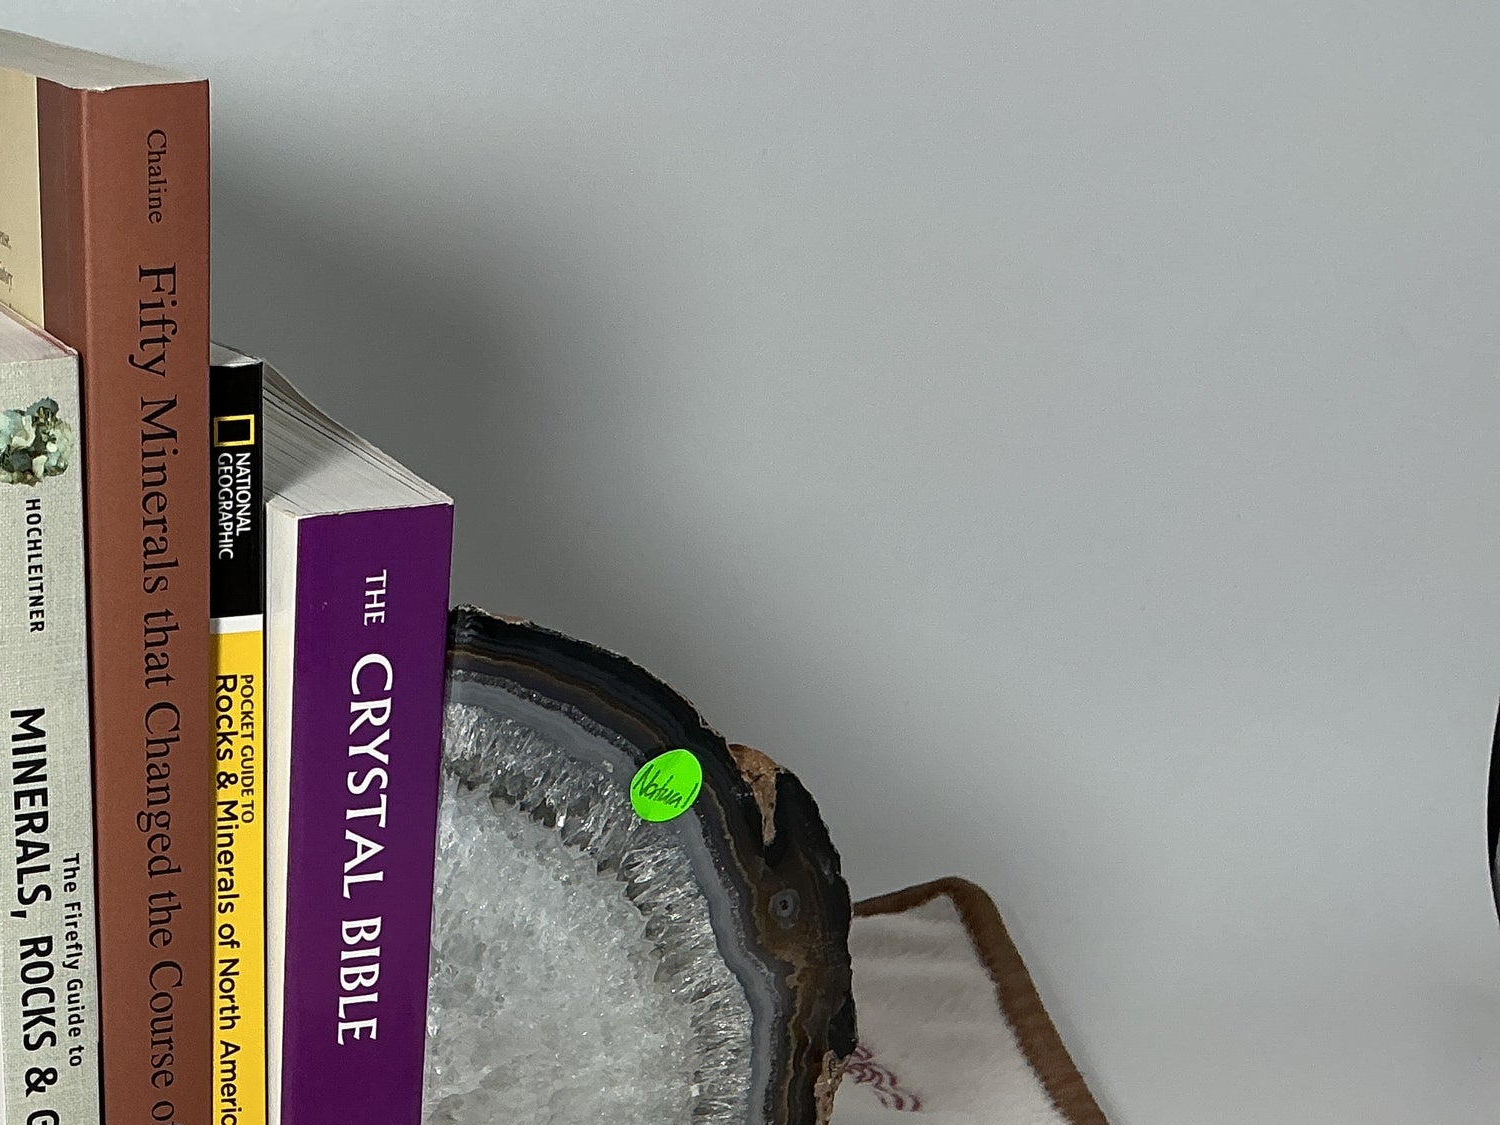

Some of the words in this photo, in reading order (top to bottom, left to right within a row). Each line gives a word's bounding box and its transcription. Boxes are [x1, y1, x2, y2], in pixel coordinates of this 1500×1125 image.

[147, 128, 167, 224] Chaline
[128, 262, 179, 378] Fifty
[140, 394, 180, 595] Minerals
[217, 452, 234, 560] GEOGRAPHIC
[235, 452, 252, 537] NATIONAL
[25, 497, 45, 633] HOCHLEITNER
[363, 568, 387, 627] THE
[143, 608, 180, 690] that
[215, 673, 238, 762] Rocks
[240, 674, 254, 741] POCKET
[137, 701, 181, 880] Changed
[216, 770, 239, 790] &
[240, 745, 255, 797] GUIDE
[240, 799, 255, 823] TO
[342, 653, 393, 900] CRYSTAL
[10, 708, 52, 919] MINERALS,
[62, 853, 80, 893] The
[216, 800, 240, 914] Minerals
[62, 901, 84, 971] Firefly
[148, 889, 183, 949] the
[217, 923, 240, 949] of
[19, 935, 57, 1052] ROCKS
[66, 978, 84, 1038] Guide
[218, 958, 242, 1030] North
[337, 915, 382, 1046] BIBLE
[68, 1044, 85, 1067] to
[149, 960, 184, 1090] Course
[25, 1067, 58, 1098] &
